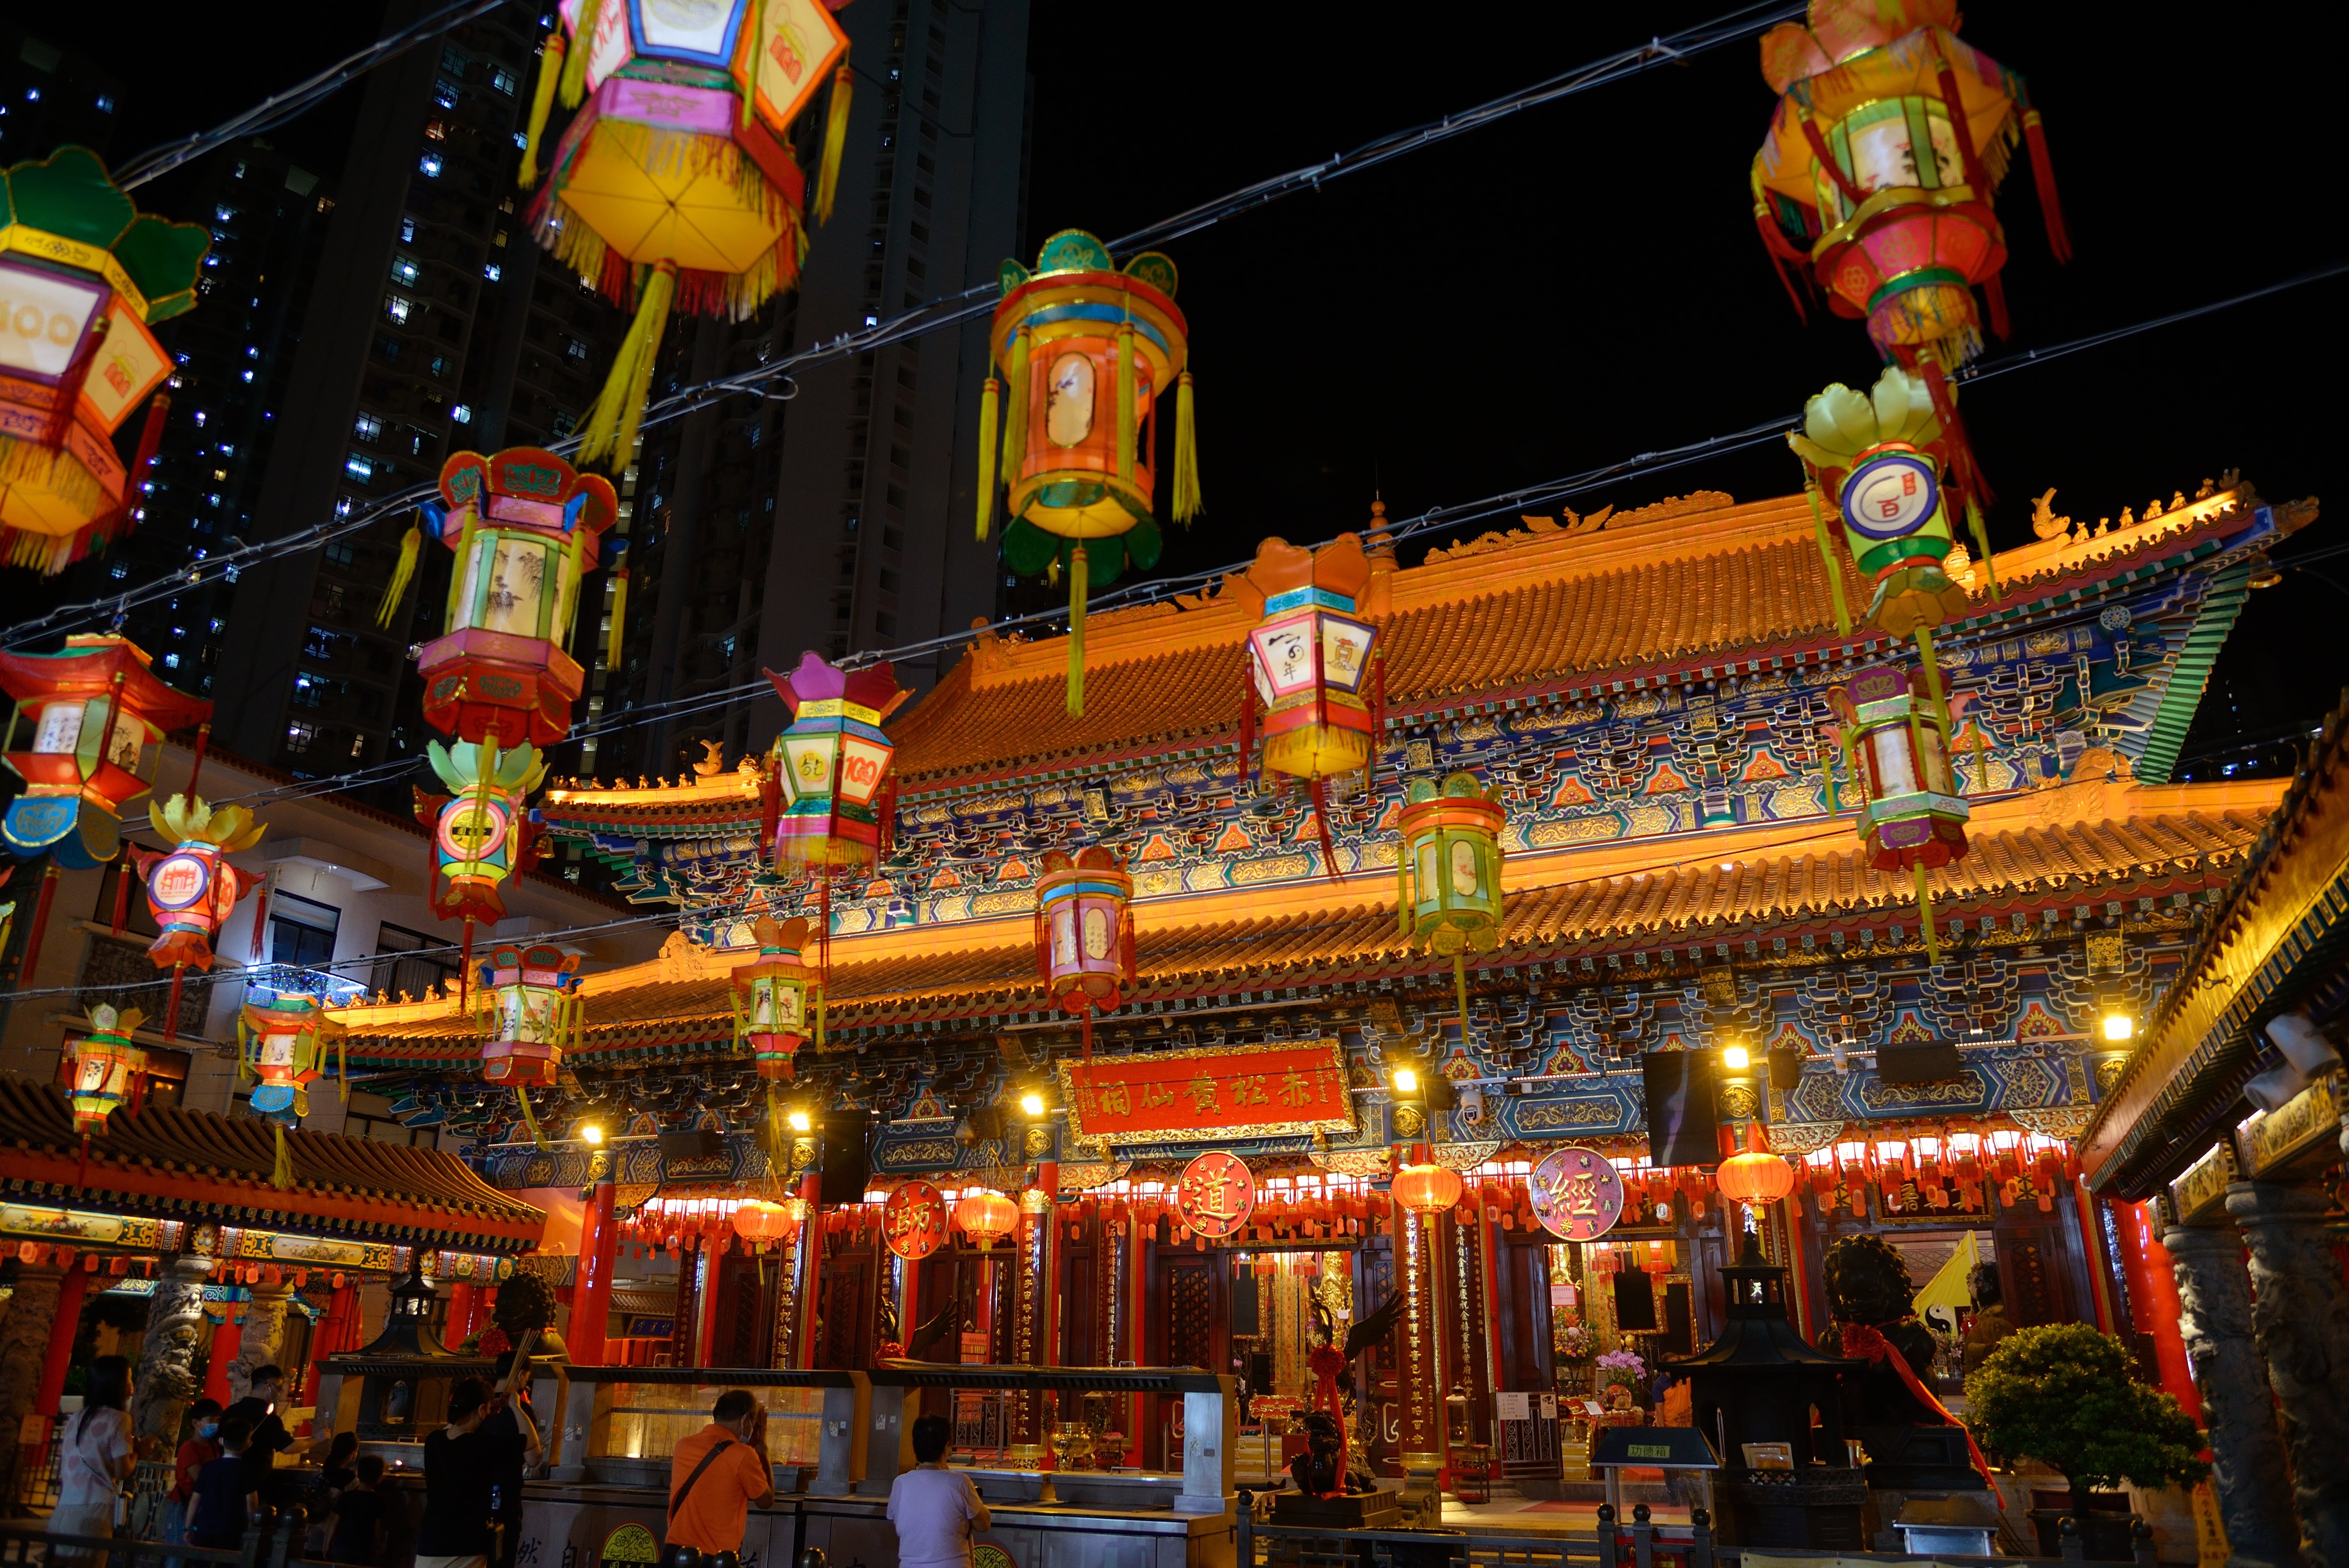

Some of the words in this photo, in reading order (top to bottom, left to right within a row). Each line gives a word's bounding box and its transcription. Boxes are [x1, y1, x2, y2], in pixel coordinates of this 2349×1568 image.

[1192, 1167, 1237, 1220] 道
[1549, 1171, 1599, 1218] 經
[898, 1197, 930, 1242] 師
[1631, 1445, 1666, 1457] 功德箱
